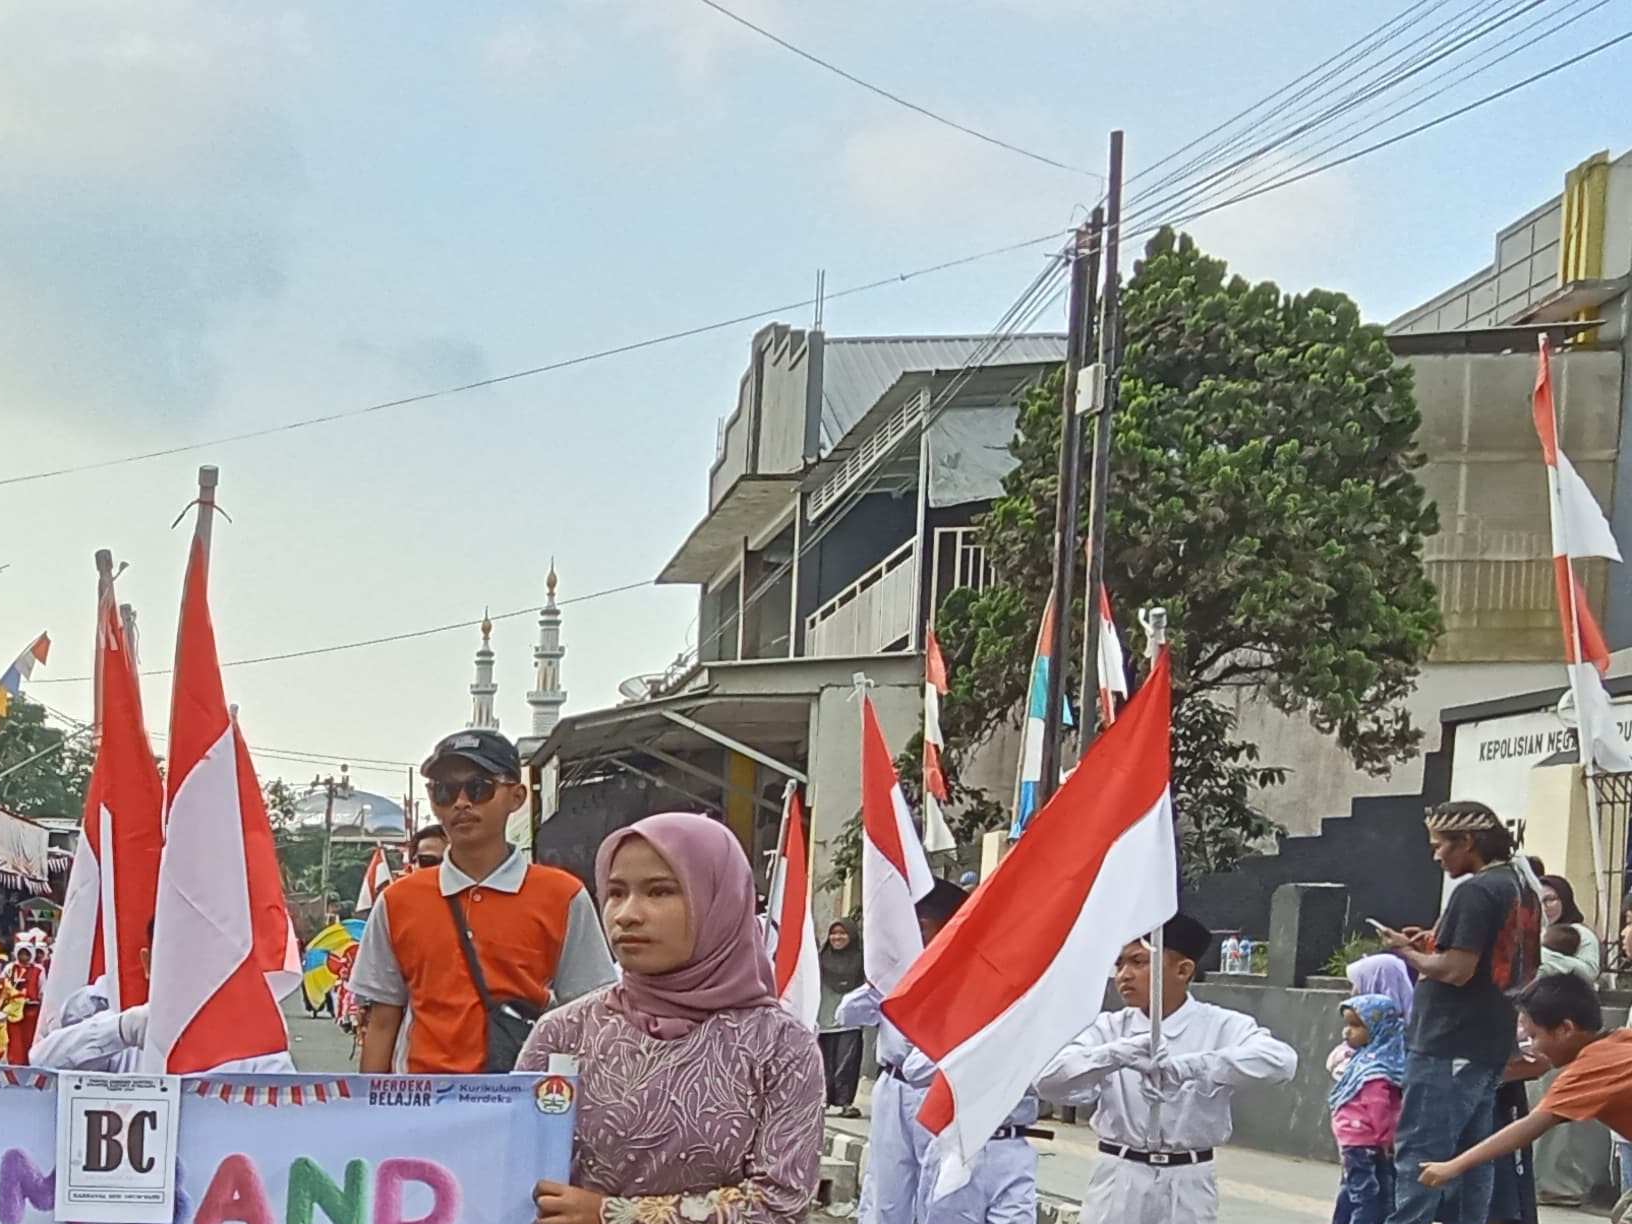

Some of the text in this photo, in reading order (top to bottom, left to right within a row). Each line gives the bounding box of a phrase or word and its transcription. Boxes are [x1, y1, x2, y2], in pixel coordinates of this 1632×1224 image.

[1479, 733, 1544, 762] KEPOLISIAN
[369, 1079, 432, 1092] MERDEKA
[459, 1084, 522, 1094] Kurikulum
[369, 1092, 431, 1106] BELAJAR
[458, 1093, 513, 1104] Merdeka
[82, 1109, 158, 1174] BC
